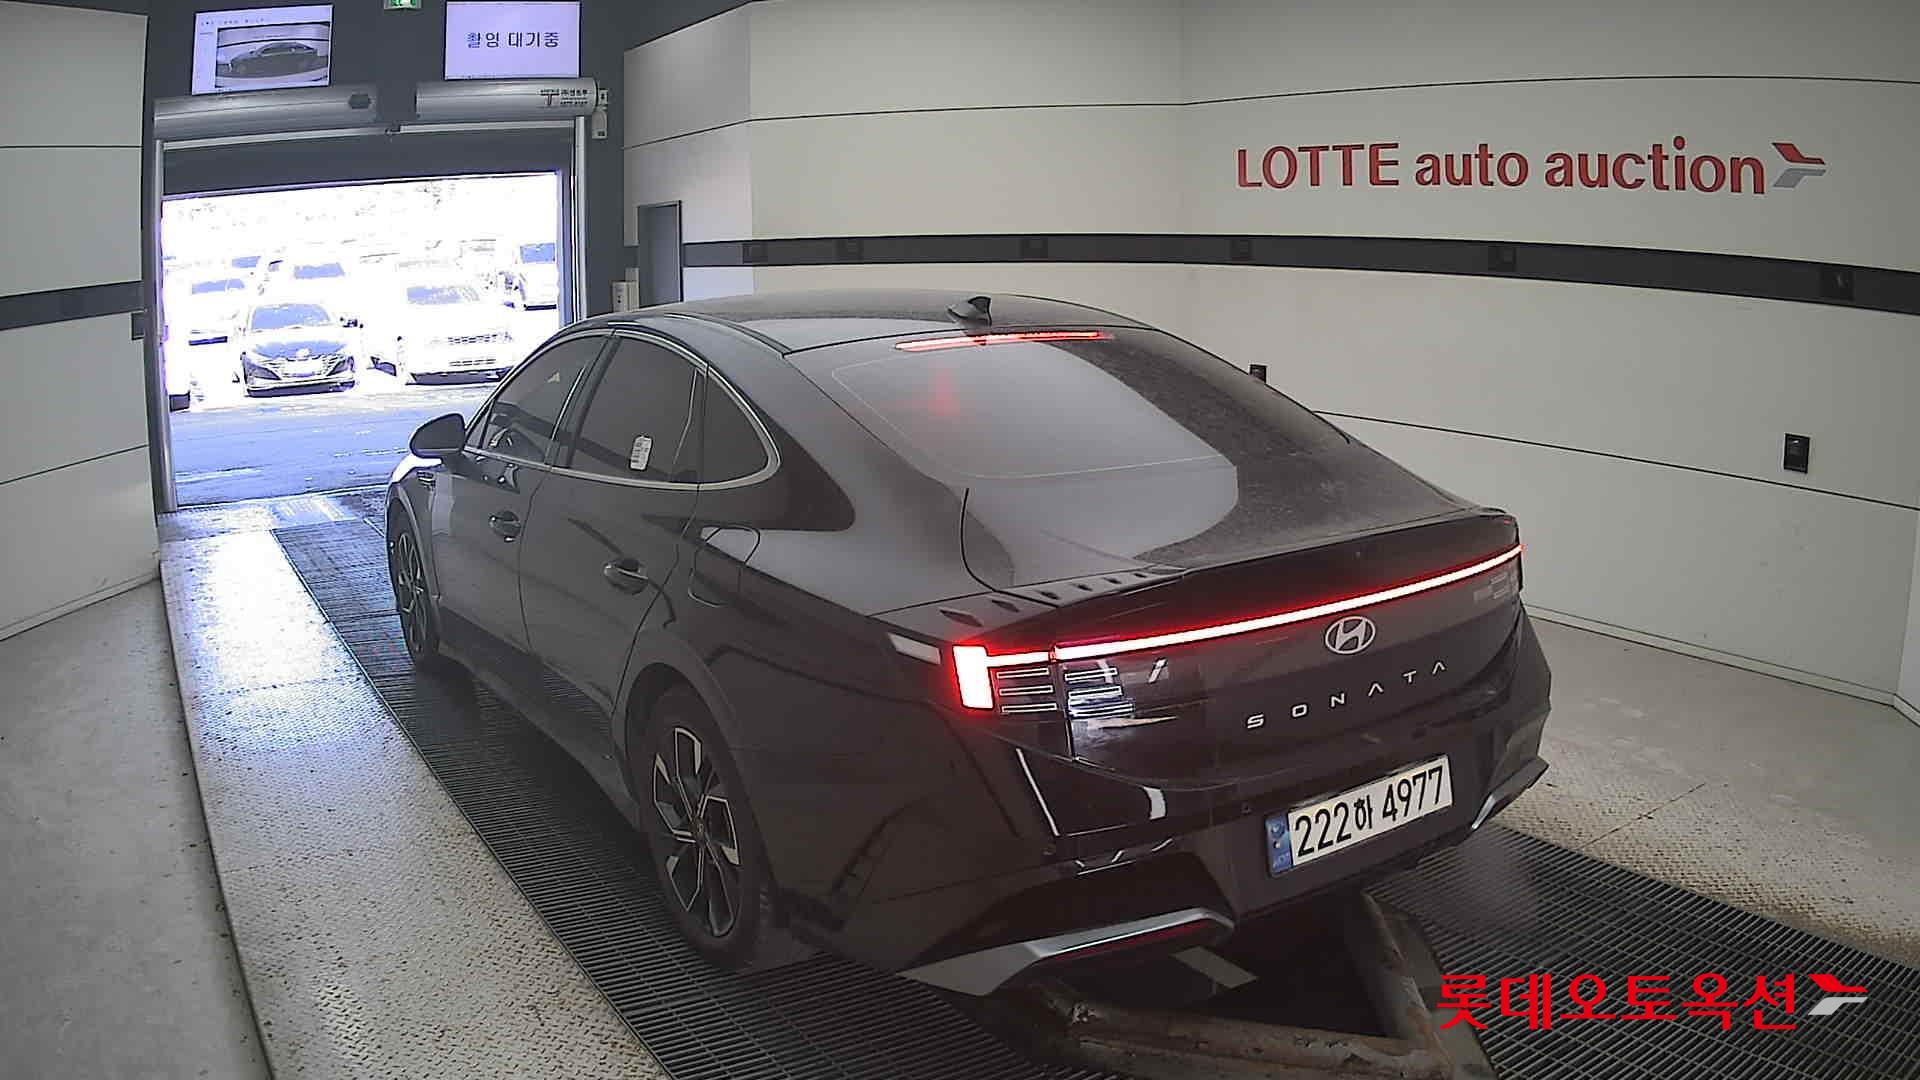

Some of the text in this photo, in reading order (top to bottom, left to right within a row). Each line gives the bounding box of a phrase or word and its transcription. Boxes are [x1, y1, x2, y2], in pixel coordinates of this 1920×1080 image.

[508, 31, 560, 49] 대기중
[1237, 135, 1766, 195] LOTTE auto auction
[1246, 660, 1447, 730] SONATA
[1294, 764, 1444, 859] 222하 4977
